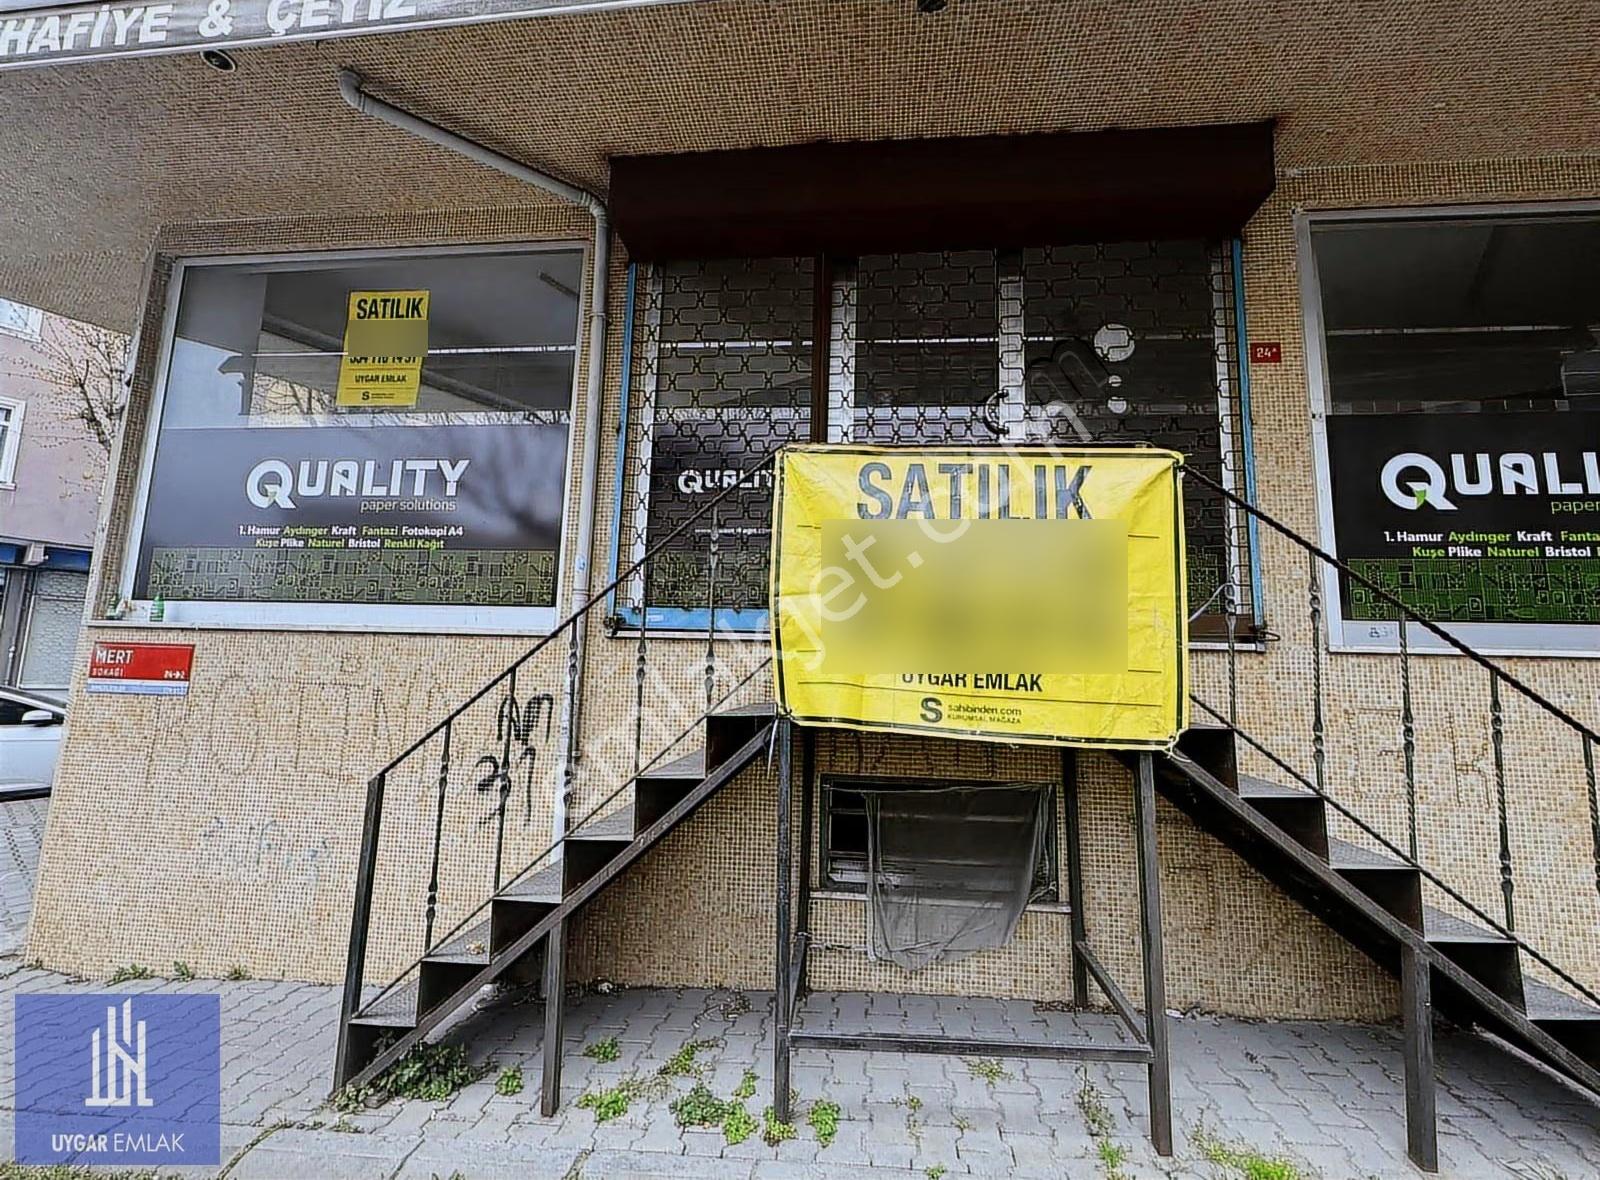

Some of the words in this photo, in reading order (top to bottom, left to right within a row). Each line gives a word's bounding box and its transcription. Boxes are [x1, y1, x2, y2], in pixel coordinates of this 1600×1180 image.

[198, 0, 233, 37] &
[357, 298, 423, 319] SATILIK
[246, 460, 471, 509] QUALITY
[857, 461, 1094, 520] SATILIK
[360, 499, 399, 513] paper
[399, 498, 457, 511] solutions
[1550, 501, 1600, 515] paper
[247, 525, 281, 535] Hamur
[331, 525, 357, 535] Kraft
[362, 525, 399, 536] Fantazi
[401, 525, 447, 537] Fotokopi
[448, 525, 464, 536] A4
[1383, 530, 1395, 542] 1.
[1396, 530, 1444, 542] Hamur
[1516, 530, 1553, 542] Kraft
[307, 538, 345, 548] Naturel
[348, 538, 381, 548] Bristol
[1448, 546, 1482, 557] Plike
[1487, 546, 1540, 557] Naturel
[1545, 545, 1592, 557] Bristol
[96, 650, 133, 664] MERT
[974, 673, 1043, 692] EMLAK
[919, 697, 943, 723] S
